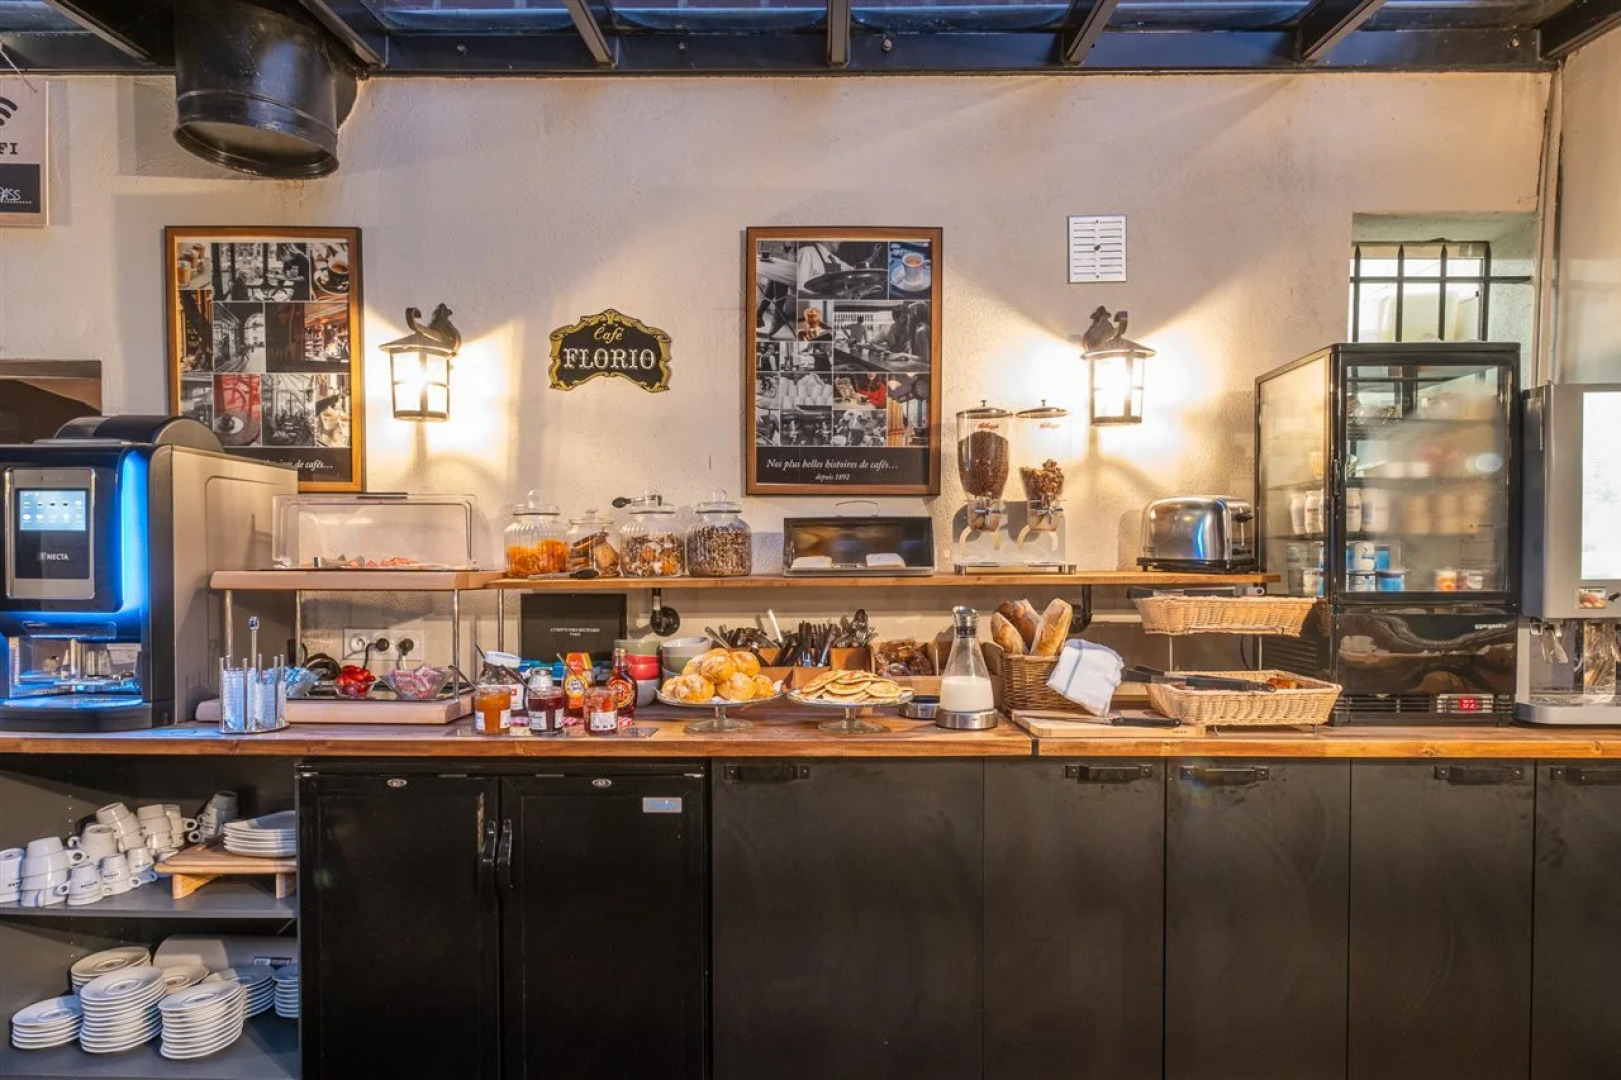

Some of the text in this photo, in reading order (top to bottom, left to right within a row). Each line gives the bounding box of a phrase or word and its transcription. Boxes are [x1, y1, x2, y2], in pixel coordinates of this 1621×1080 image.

[593, 327, 624, 344] Café
[563, 348, 656, 369] FLORIO
[766, 459, 782, 468] Nos
[783, 459, 801, 471] plus
[802, 459, 823, 468] belles
[825, 459, 858, 468] histoires
[859, 459, 869, 468] de
[815, 473, 851, 482] depuis 1892
[46, 553, 69, 561] NECTA
